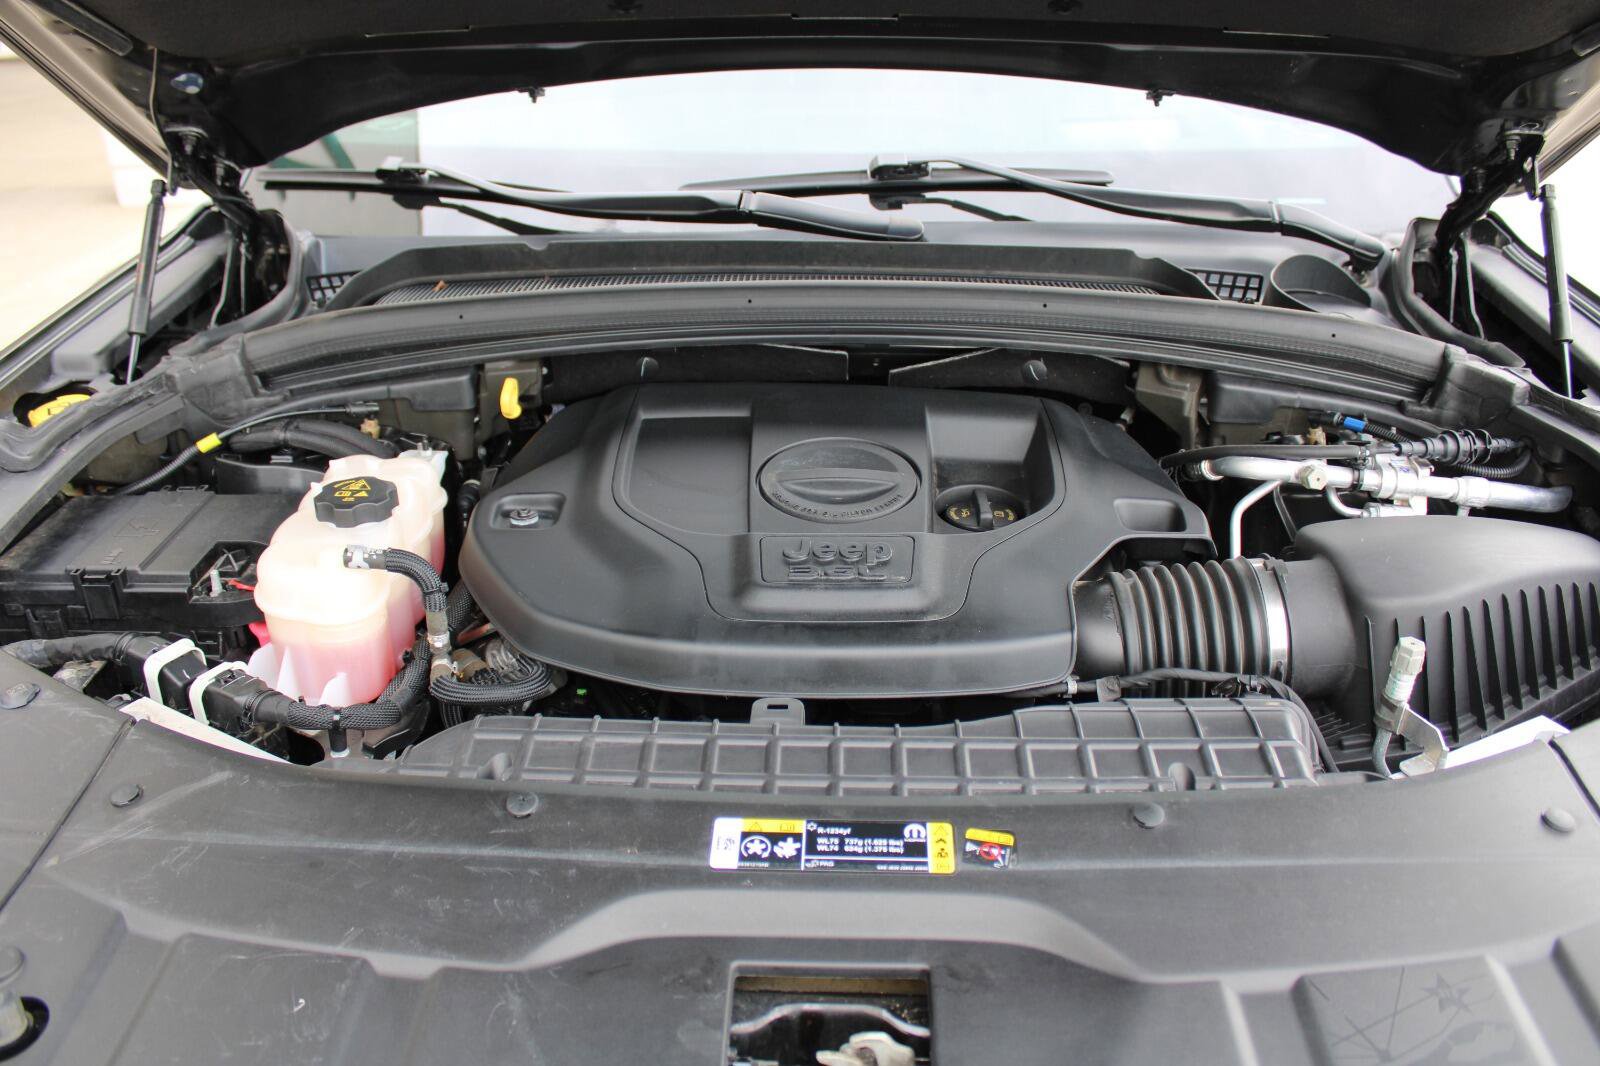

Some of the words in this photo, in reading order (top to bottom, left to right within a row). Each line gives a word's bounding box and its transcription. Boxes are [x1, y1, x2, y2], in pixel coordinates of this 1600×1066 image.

[782, 537, 893, 566] Jeep
[817, 827, 851, 836] R-1234yf
[817, 837, 839, 845] WL75
[844, 837, 863, 846] 737g
[817, 844, 839, 852] WL74
